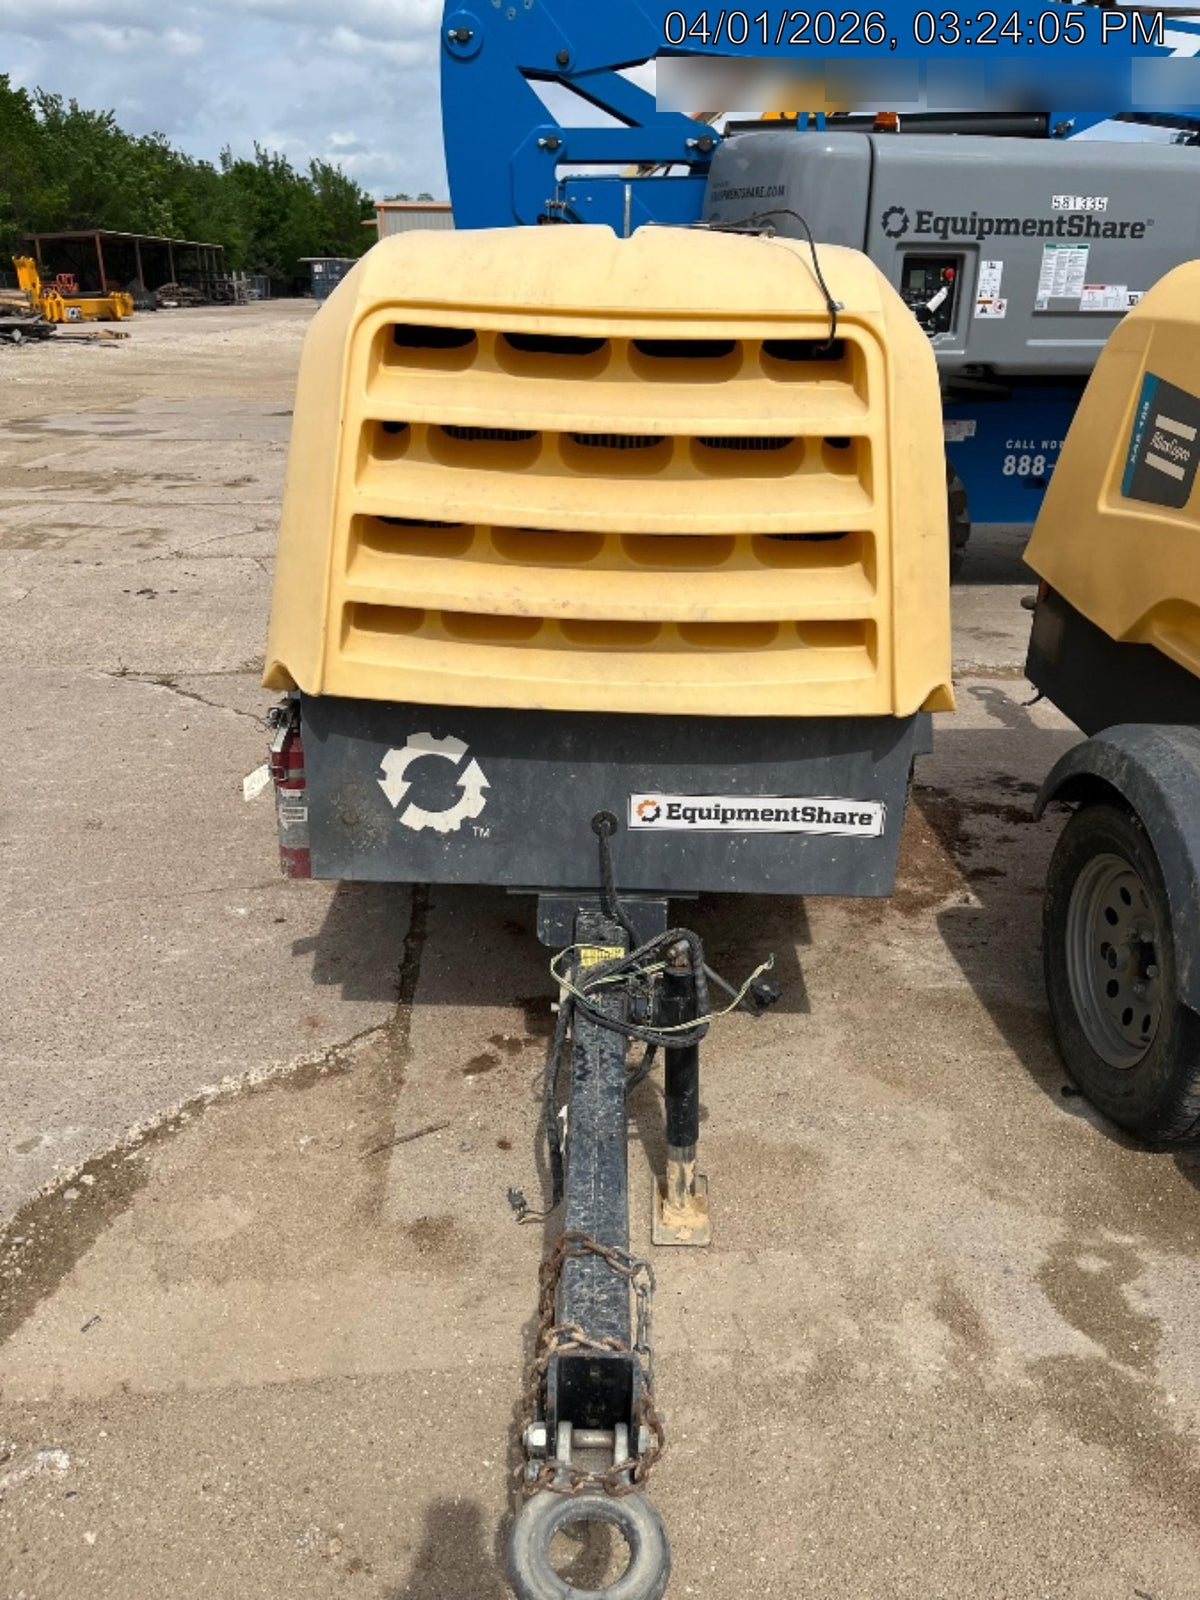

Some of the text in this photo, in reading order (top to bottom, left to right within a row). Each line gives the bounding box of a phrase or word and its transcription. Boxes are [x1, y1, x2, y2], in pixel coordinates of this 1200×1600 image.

[1053, 196, 1106, 211] 581335
[1005, 439, 1036, 449] CALL
[665, 802, 873, 826] EquipmentShare
[472, 825, 490, 838] TM
